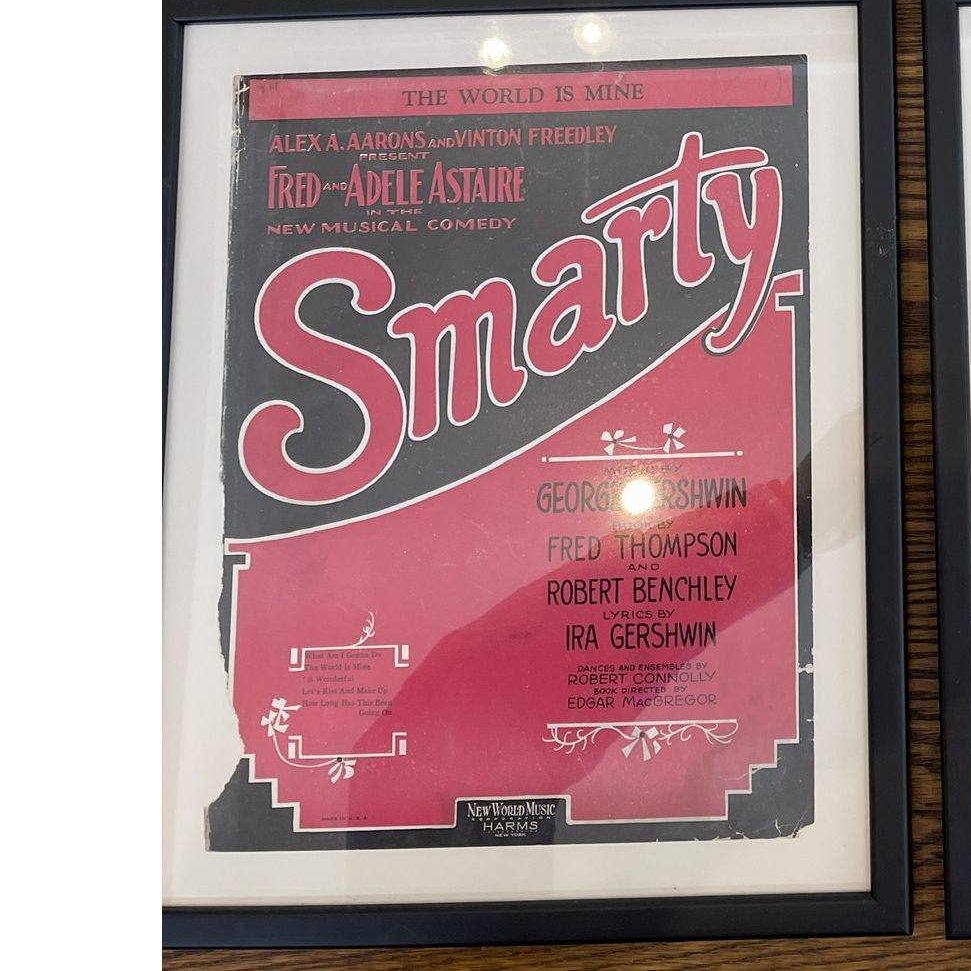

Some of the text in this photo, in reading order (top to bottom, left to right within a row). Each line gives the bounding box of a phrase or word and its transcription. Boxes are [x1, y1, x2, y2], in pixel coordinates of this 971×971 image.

[401, 83, 645, 107] THE WORLD IS MINE
[267, 125, 617, 154] ALEX A. AARONS AND VINTON FREEDLEY
[359, 151, 431, 162] PRESENT
[267, 160, 526, 209] FRED AND ADELE ASTAIRE
[365, 208, 424, 217] IN THE
[267, 217, 518, 236] NEW MUSICAL COMEDY
[237, 131, 784, 506] Smarty
[657, 520, 674, 530] BY
[547, 531, 738, 562] FRED THOMPSON
[627, 563, 661, 572] AND
[547, 574, 738, 606] ROBERT BENCHLEY
[603, 608, 676, 621] LYRICS BY
[566, 621, 717, 651] IRA GERSHWIN
[578, 661, 709, 673] DANCES AND ENSEMBLES BY
[567, 671, 718, 686] ROBERT CONNOLLY
[593, 685, 688, 696] BOOK DIRECTED BY
[567, 696, 616, 710] EDGAR
[466, 800, 556, 818] NEW WORLD MUSIC
[483, 821, 539, 832] HARMS
